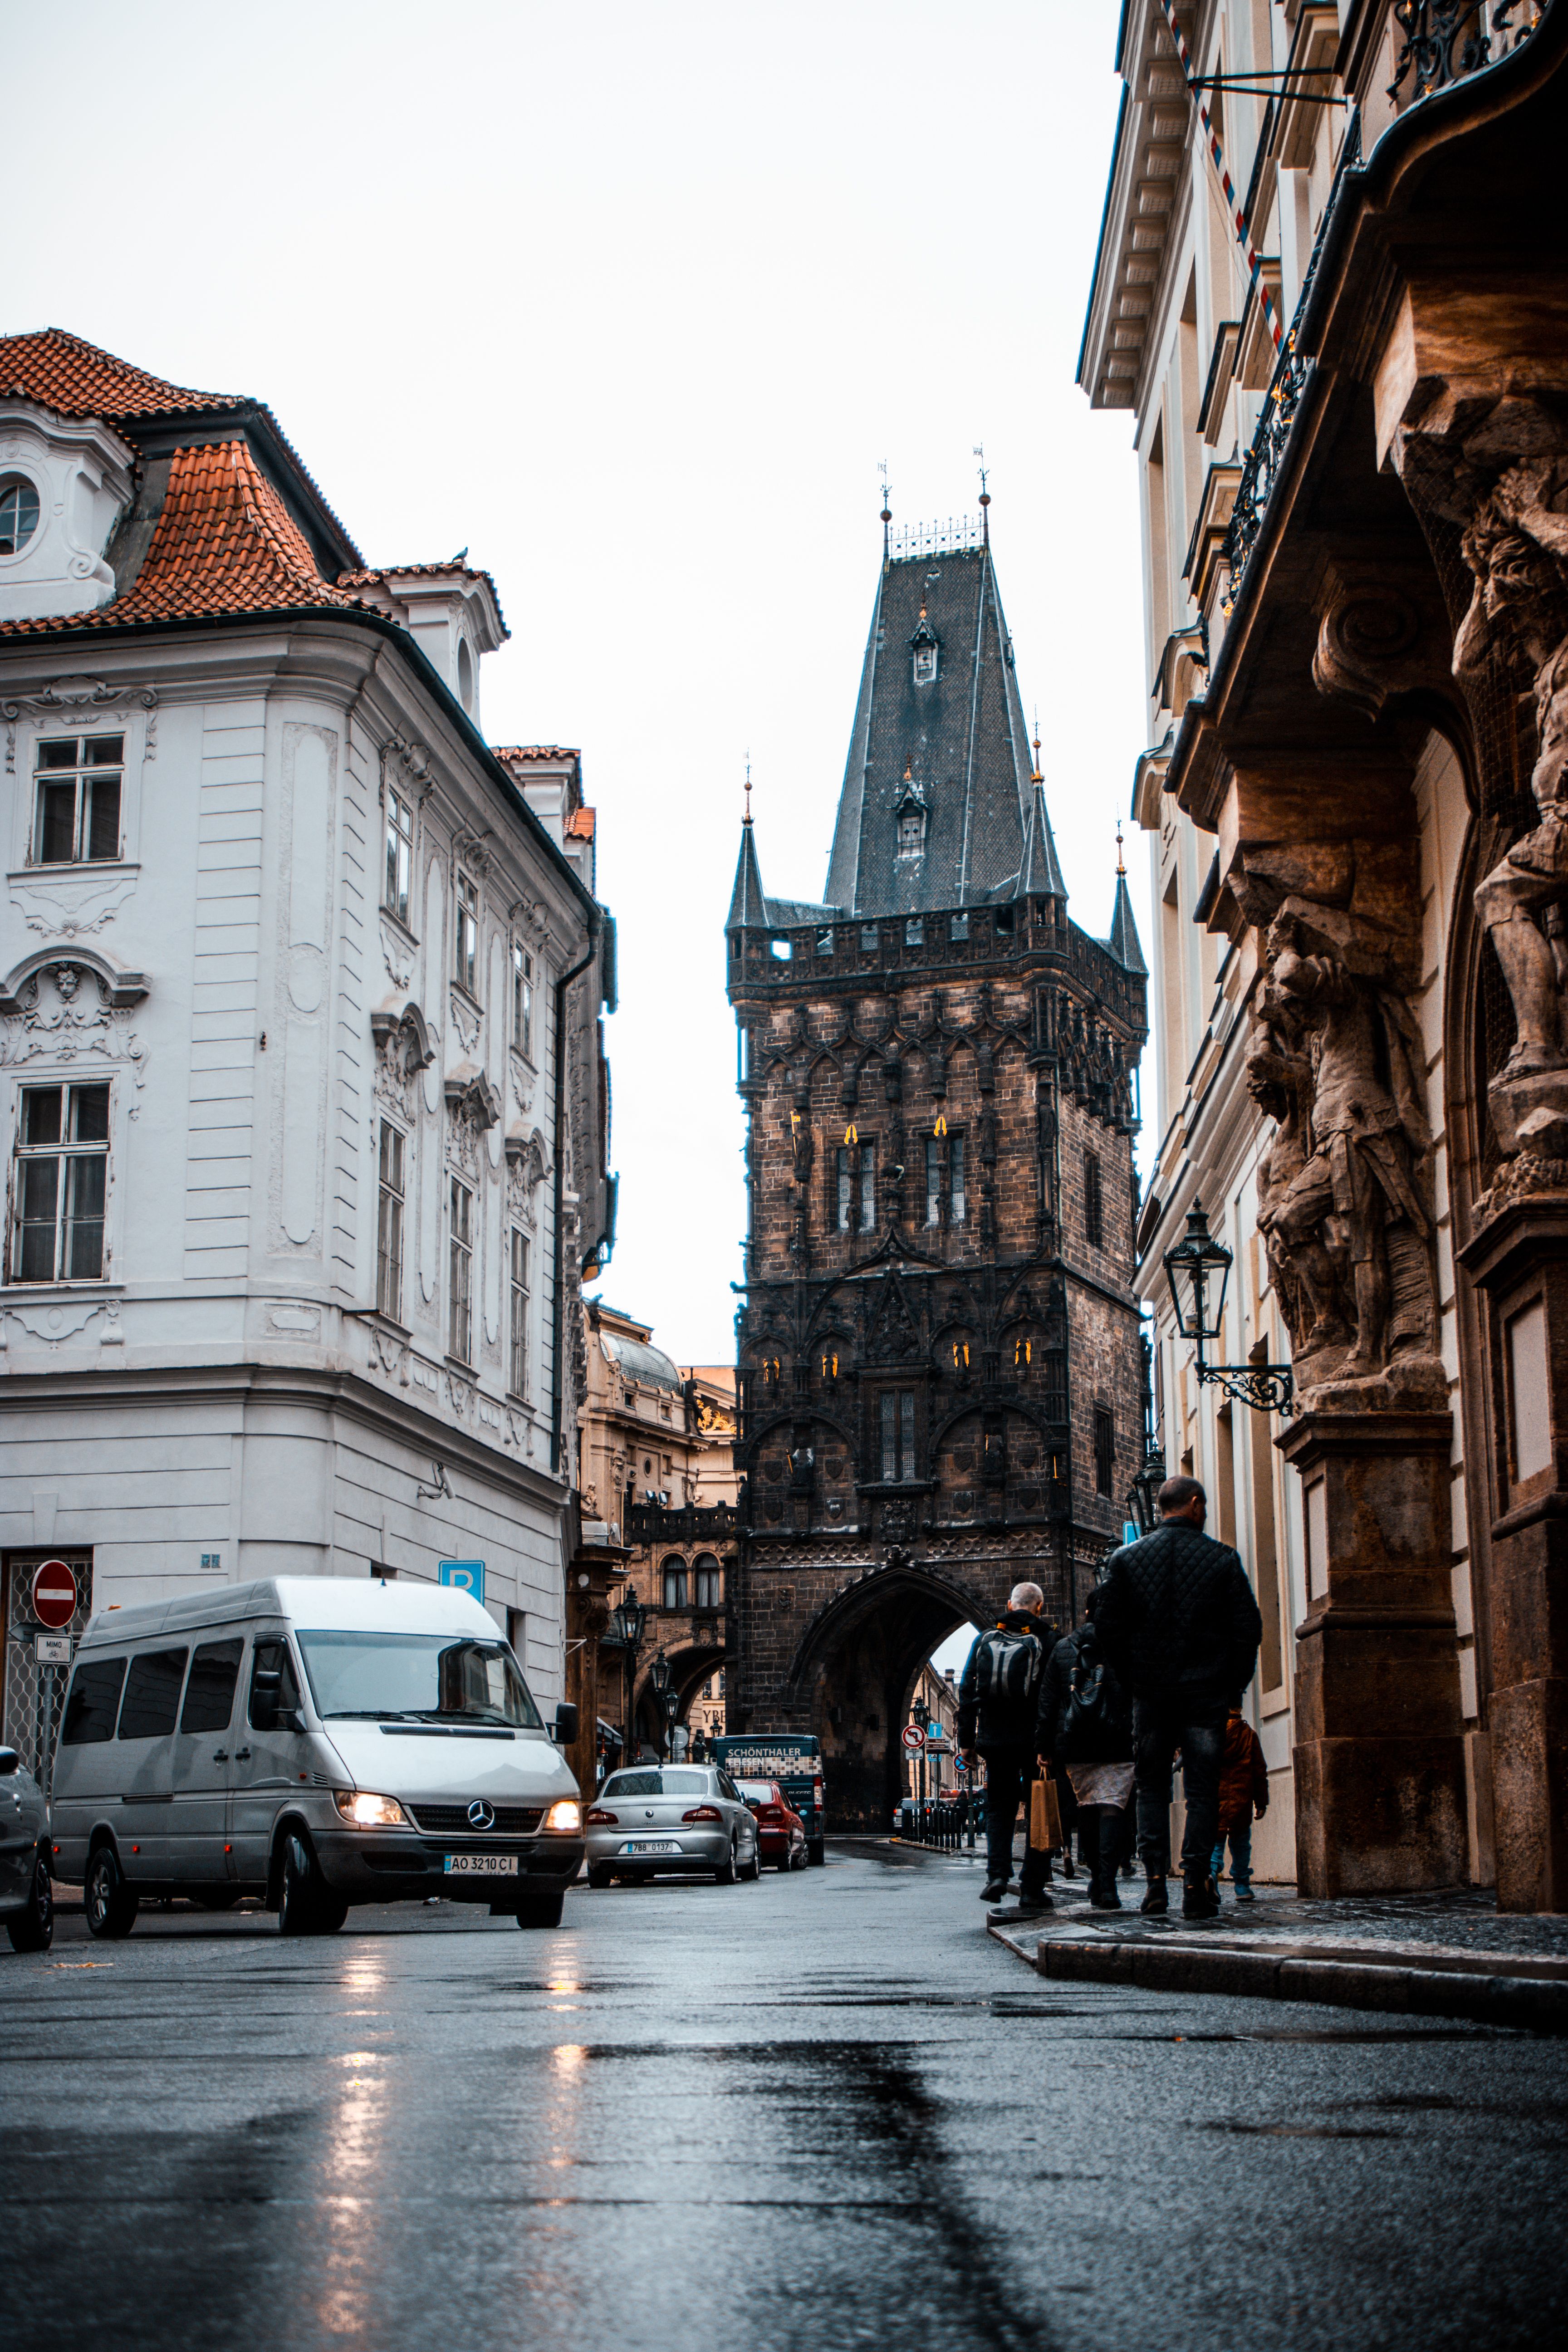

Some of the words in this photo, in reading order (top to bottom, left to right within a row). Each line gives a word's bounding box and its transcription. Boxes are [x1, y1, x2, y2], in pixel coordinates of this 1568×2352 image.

[450, 1570, 473, 1590] P
[728, 1747, 801, 1757] SCHÖNTHALER
[728, 1758, 764, 1766] FLIESEN
[452, 1857, 468, 1869] AO
[471, 1857, 496, 1869] 3210
[500, 1858, 512, 1870] CI
